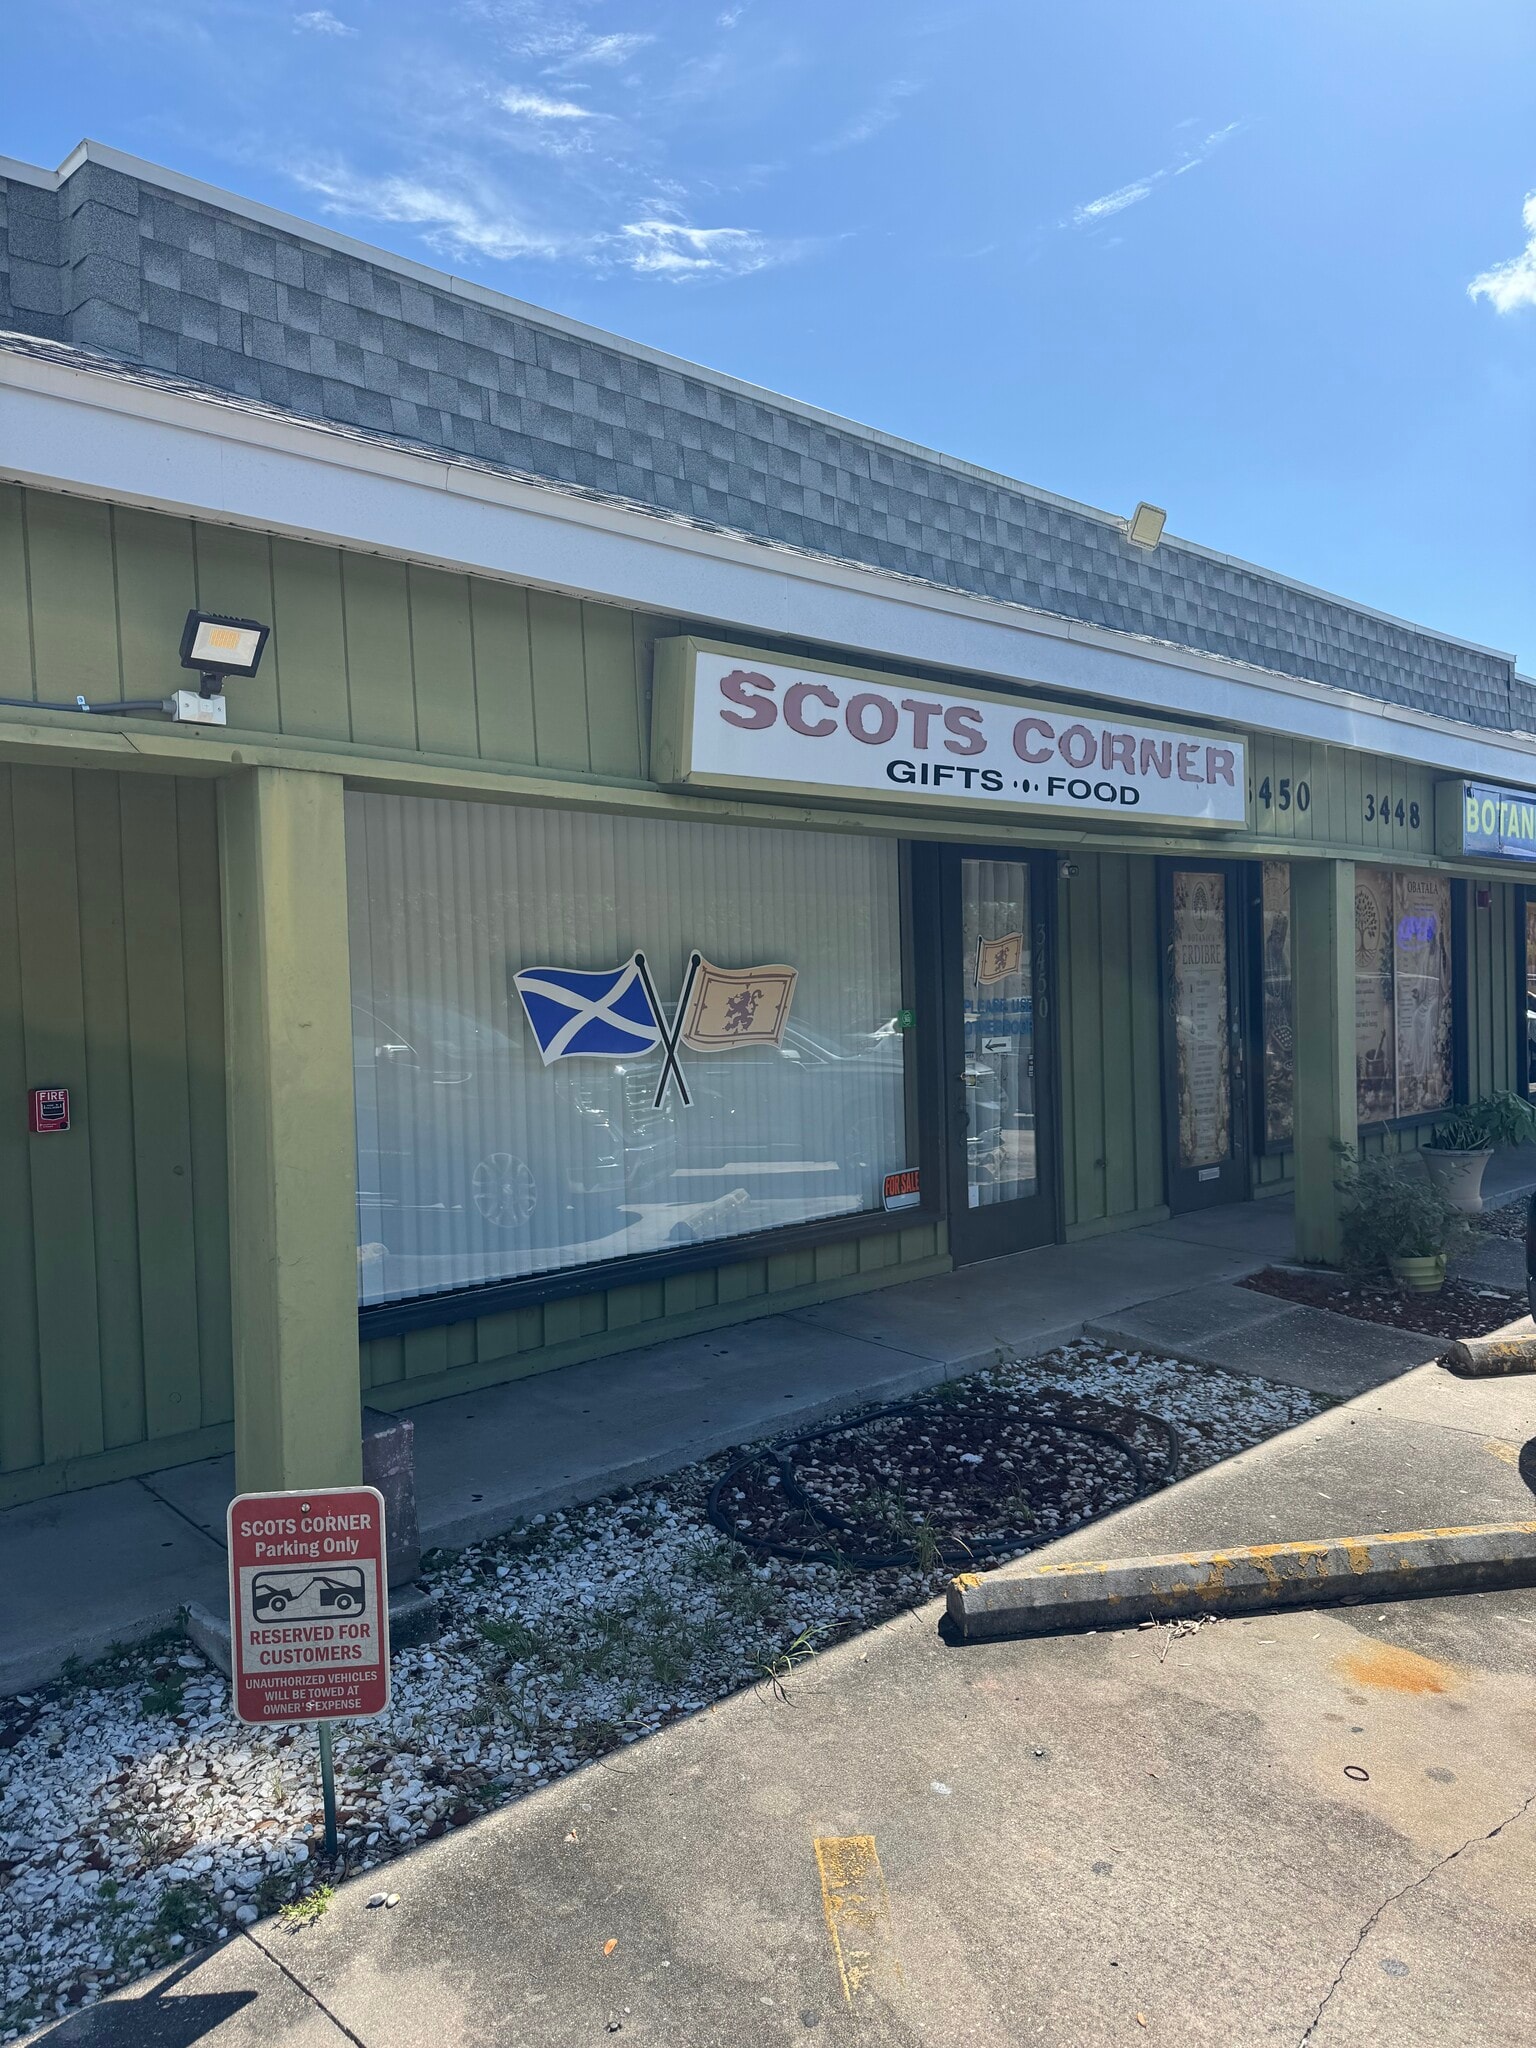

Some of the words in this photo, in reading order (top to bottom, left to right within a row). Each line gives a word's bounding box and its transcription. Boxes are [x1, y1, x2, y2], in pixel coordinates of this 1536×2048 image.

[720, 669, 987, 755] SCOTS
[1013, 718, 1235, 786] CORNER
[886, 760, 1004, 792] GIFTS
[1047, 776, 1140, 806] FOOD
[1249, 776, 1310, 811] 450
[1364, 794, 1420, 829] 3448
[1407, 881, 1438, 895] OBATALA
[40, 1091, 65, 1101] FIRE
[885, 1175, 900, 1197] FOR
[901, 1171, 920, 1194] SALE
[241, 1518, 297, 1537] SCOTS
[301, 1514, 371, 1533] CORNER
[255, 1540, 320, 1558] Parking
[323, 1536, 359, 1555] Only
[250, 1626, 334, 1645] RESERVED
[339, 1623, 371, 1640] FOR
[260, 1644, 362, 1665] CUSTOMERS
[245, 1674, 326, 1689] UNAUTHORIZED
[327, 1671, 378, 1684] VEHICLES
[265, 1690, 290, 1701] WILL
[292, 1688, 307, 1699] BE
[309, 1686, 344, 1698] TOWED
[347, 1685, 359, 1695] AT
[263, 1702, 313, 1714] OWNER'S
[315, 1698, 362, 1711] EXPENSE
